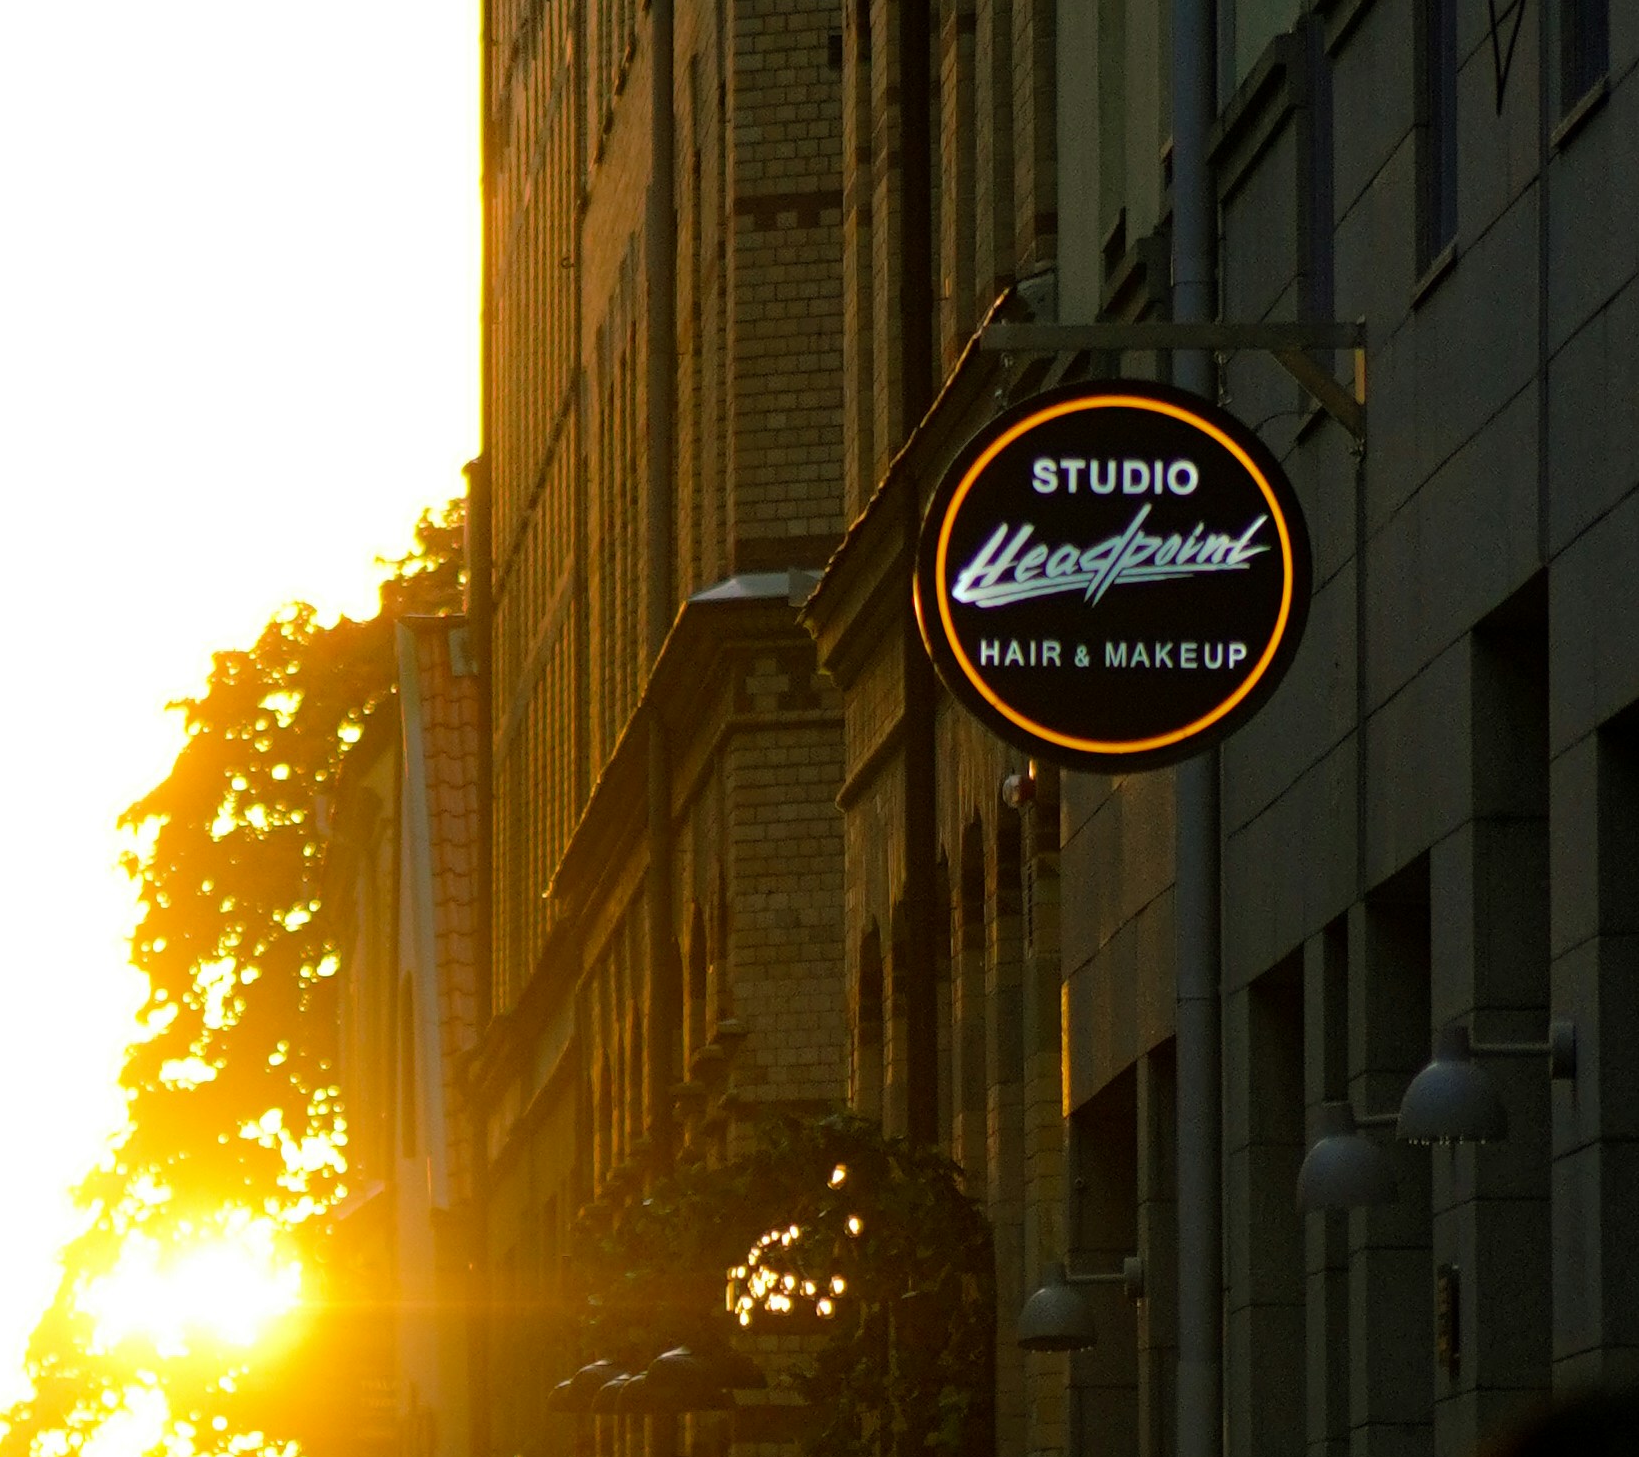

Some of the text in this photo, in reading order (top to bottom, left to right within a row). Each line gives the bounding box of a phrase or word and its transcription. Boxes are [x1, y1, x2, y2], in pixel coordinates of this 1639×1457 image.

[1032, 457, 1199, 496] STUDIO
[952, 502, 1271, 607] Headpoint
[979, 639, 1248, 670] HAIR & MAKEUP
